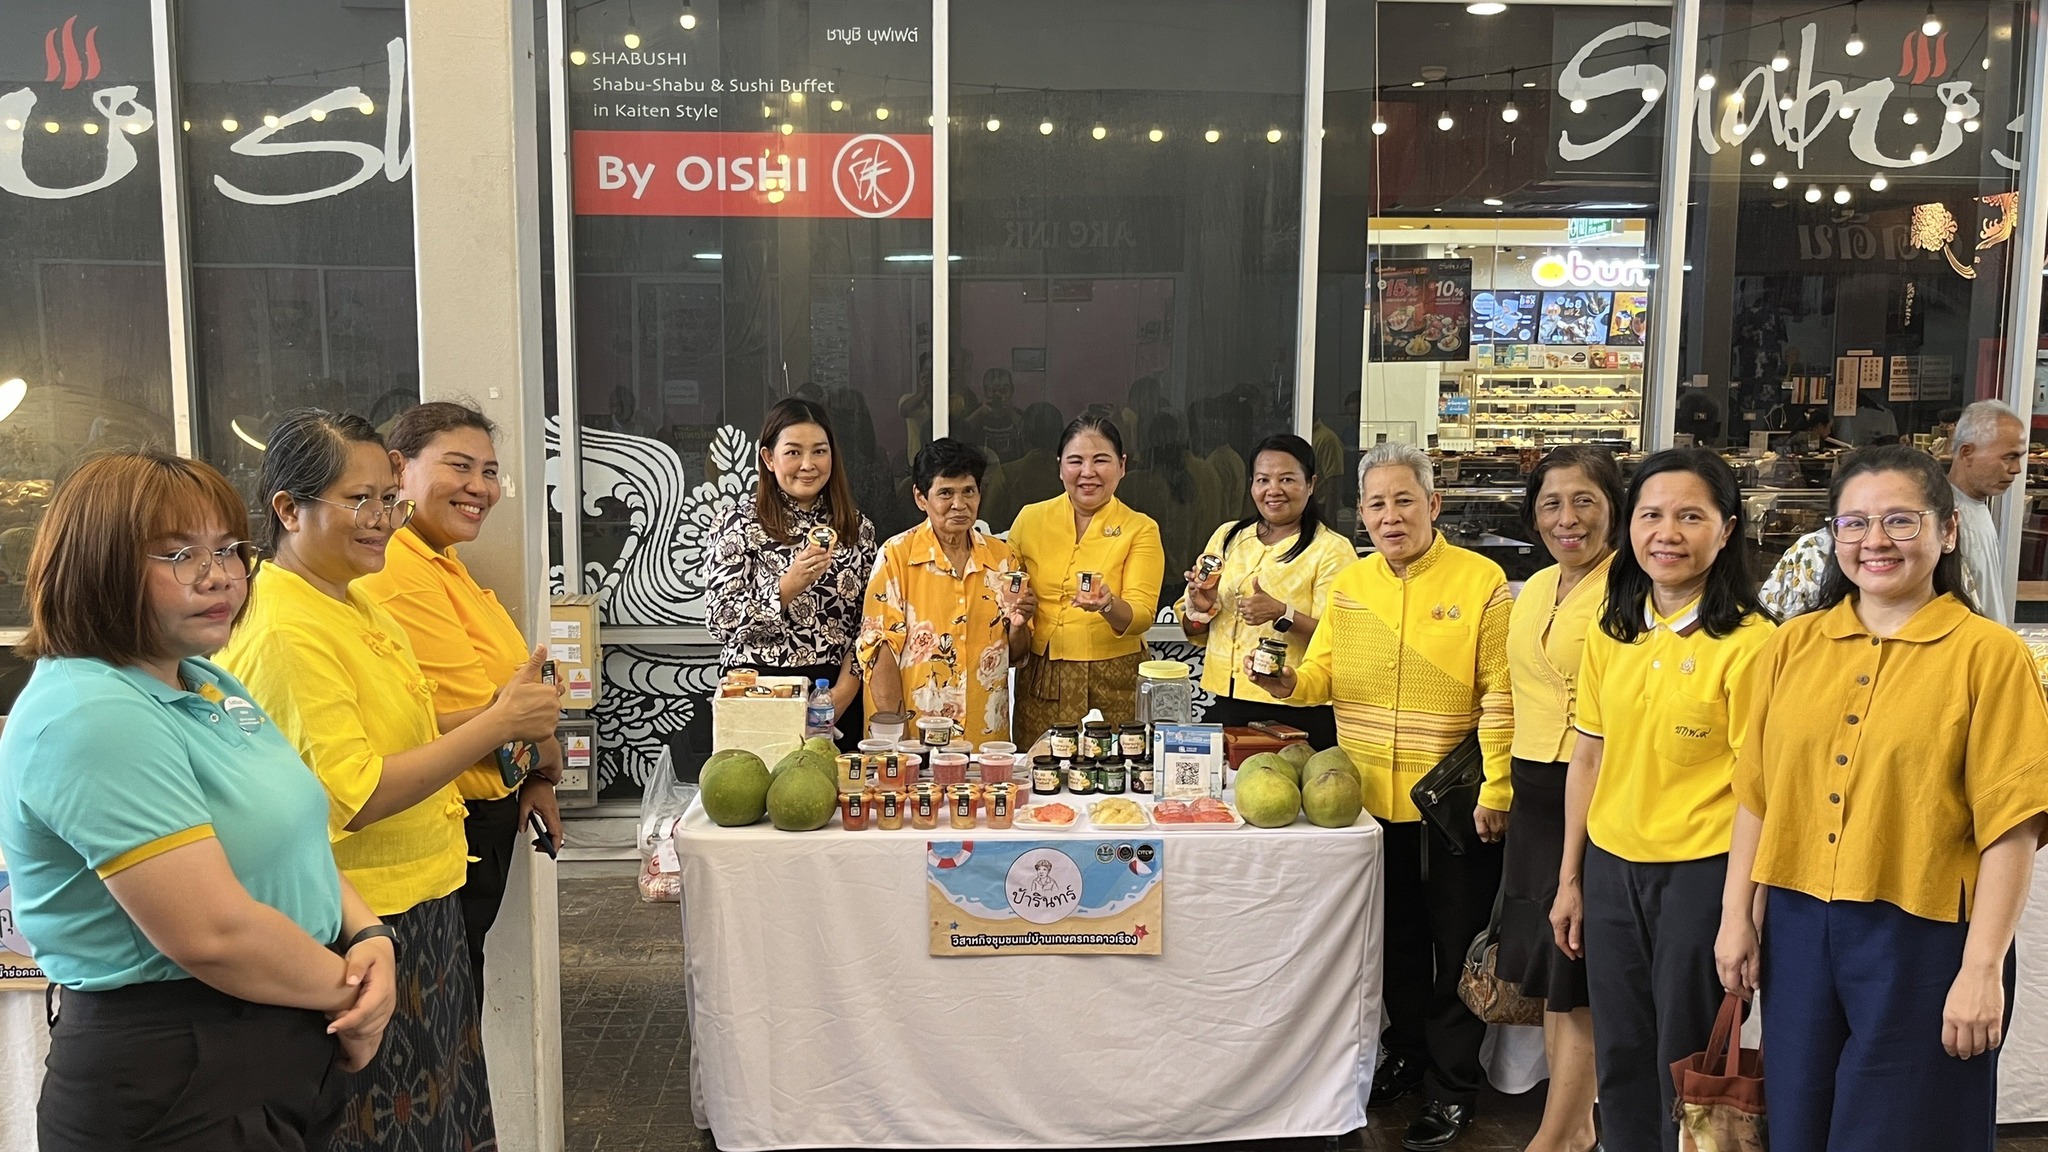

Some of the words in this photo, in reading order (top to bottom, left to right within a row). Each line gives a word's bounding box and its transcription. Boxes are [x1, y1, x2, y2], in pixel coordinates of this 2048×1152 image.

[826, 27, 862, 45] ชาบูชิ
[592, 52, 687, 66] SHABUSHI
[593, 77, 705, 92] Shabu-Shabu
[711, 78, 725, 92] &
[729, 78, 774, 92] Sushi
[780, 79, 835, 93] Buffet
[593, 103, 609, 117] in
[615, 104, 670, 117] Kaiten
[676, 104, 718, 121] Style
[599, 155, 656, 199] By
[676, 156, 806, 191] OISHI
[1435, 279, 1464, 298] 10%
